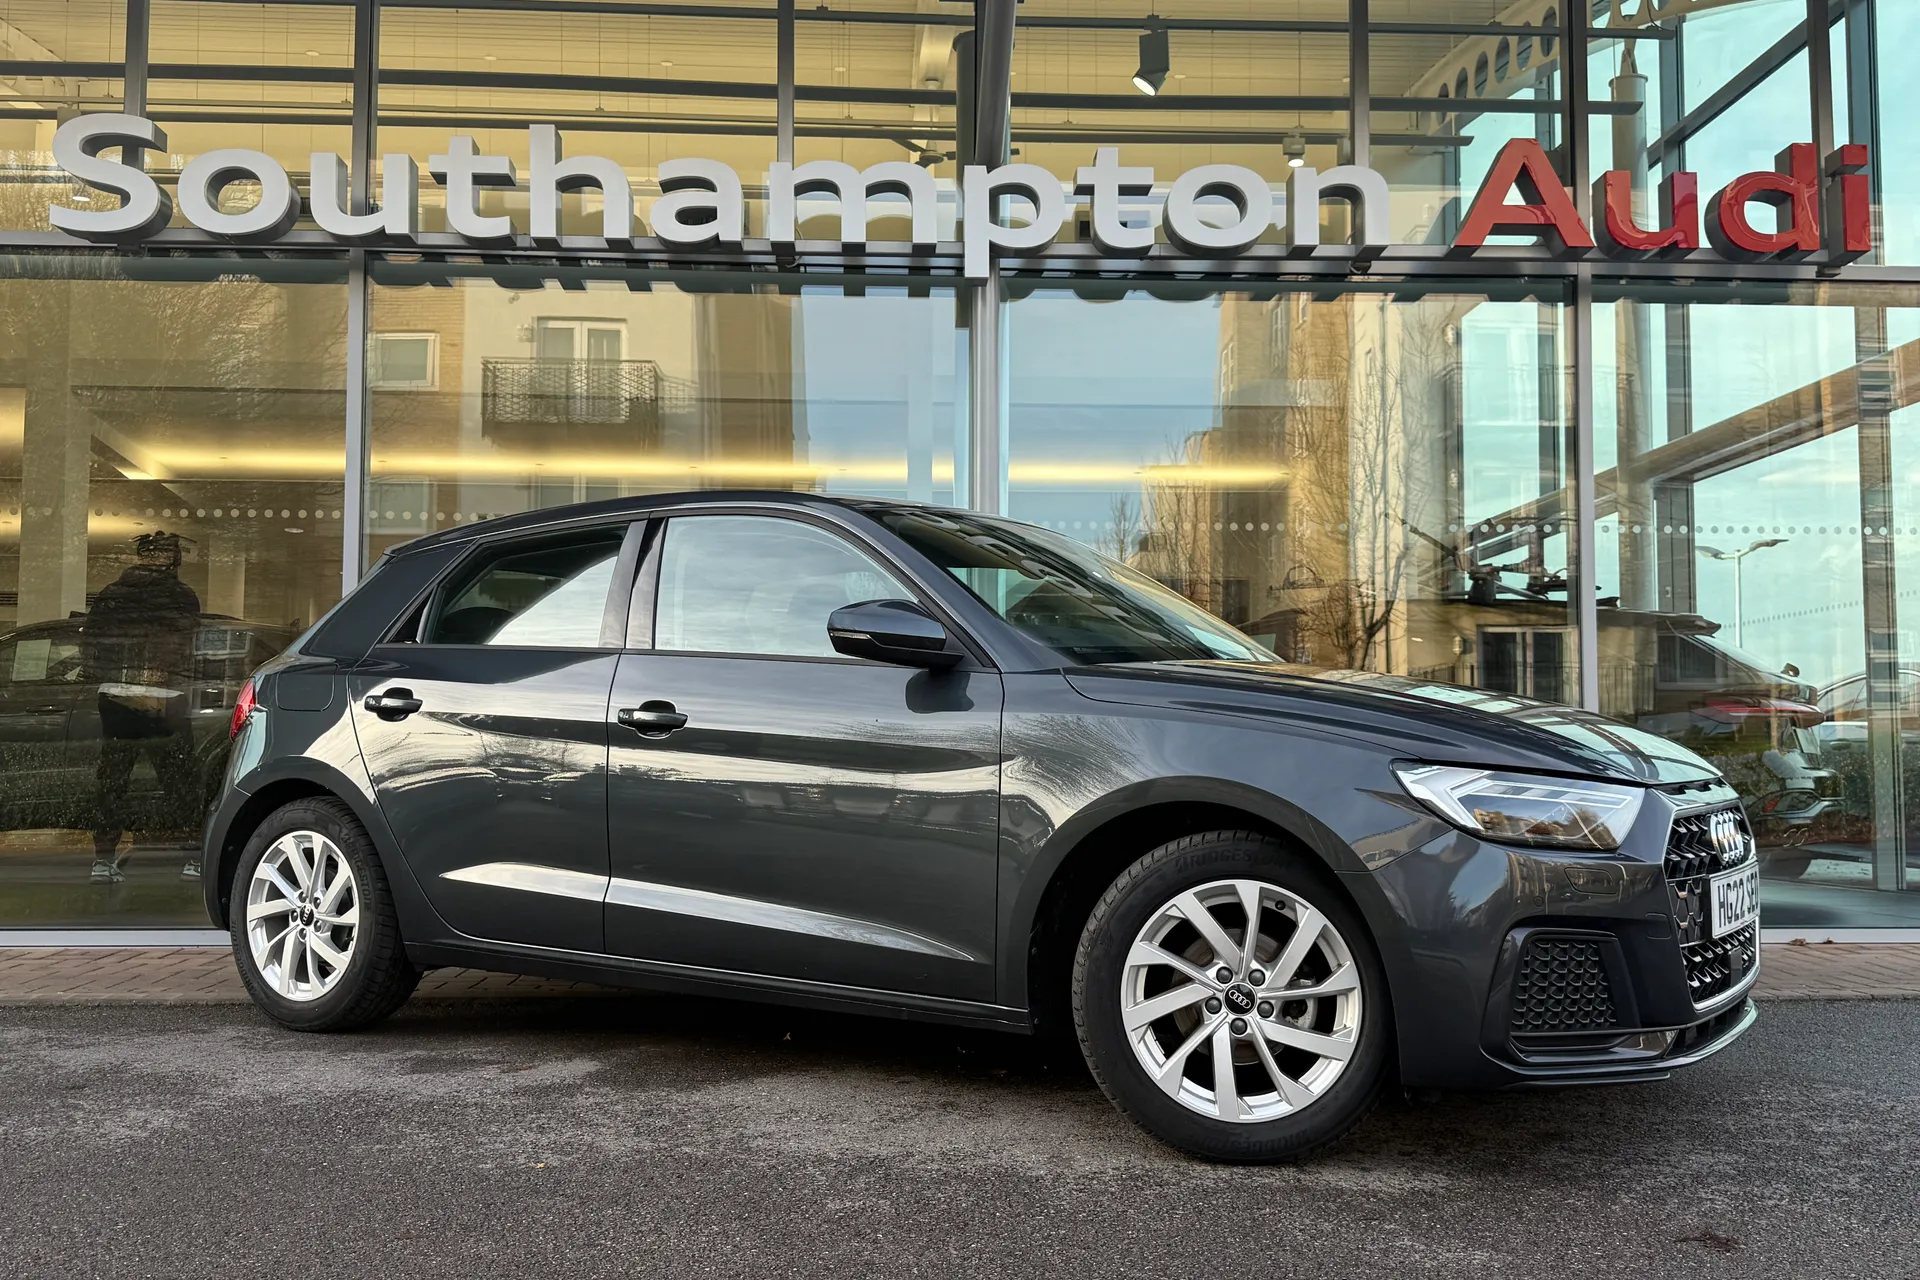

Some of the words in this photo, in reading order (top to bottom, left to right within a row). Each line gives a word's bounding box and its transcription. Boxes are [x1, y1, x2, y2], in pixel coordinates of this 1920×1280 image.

[49, 113, 1390, 280] Southampton
[1453, 137, 1871, 256] Audi
[1717, 878, 1746, 928] HG22
